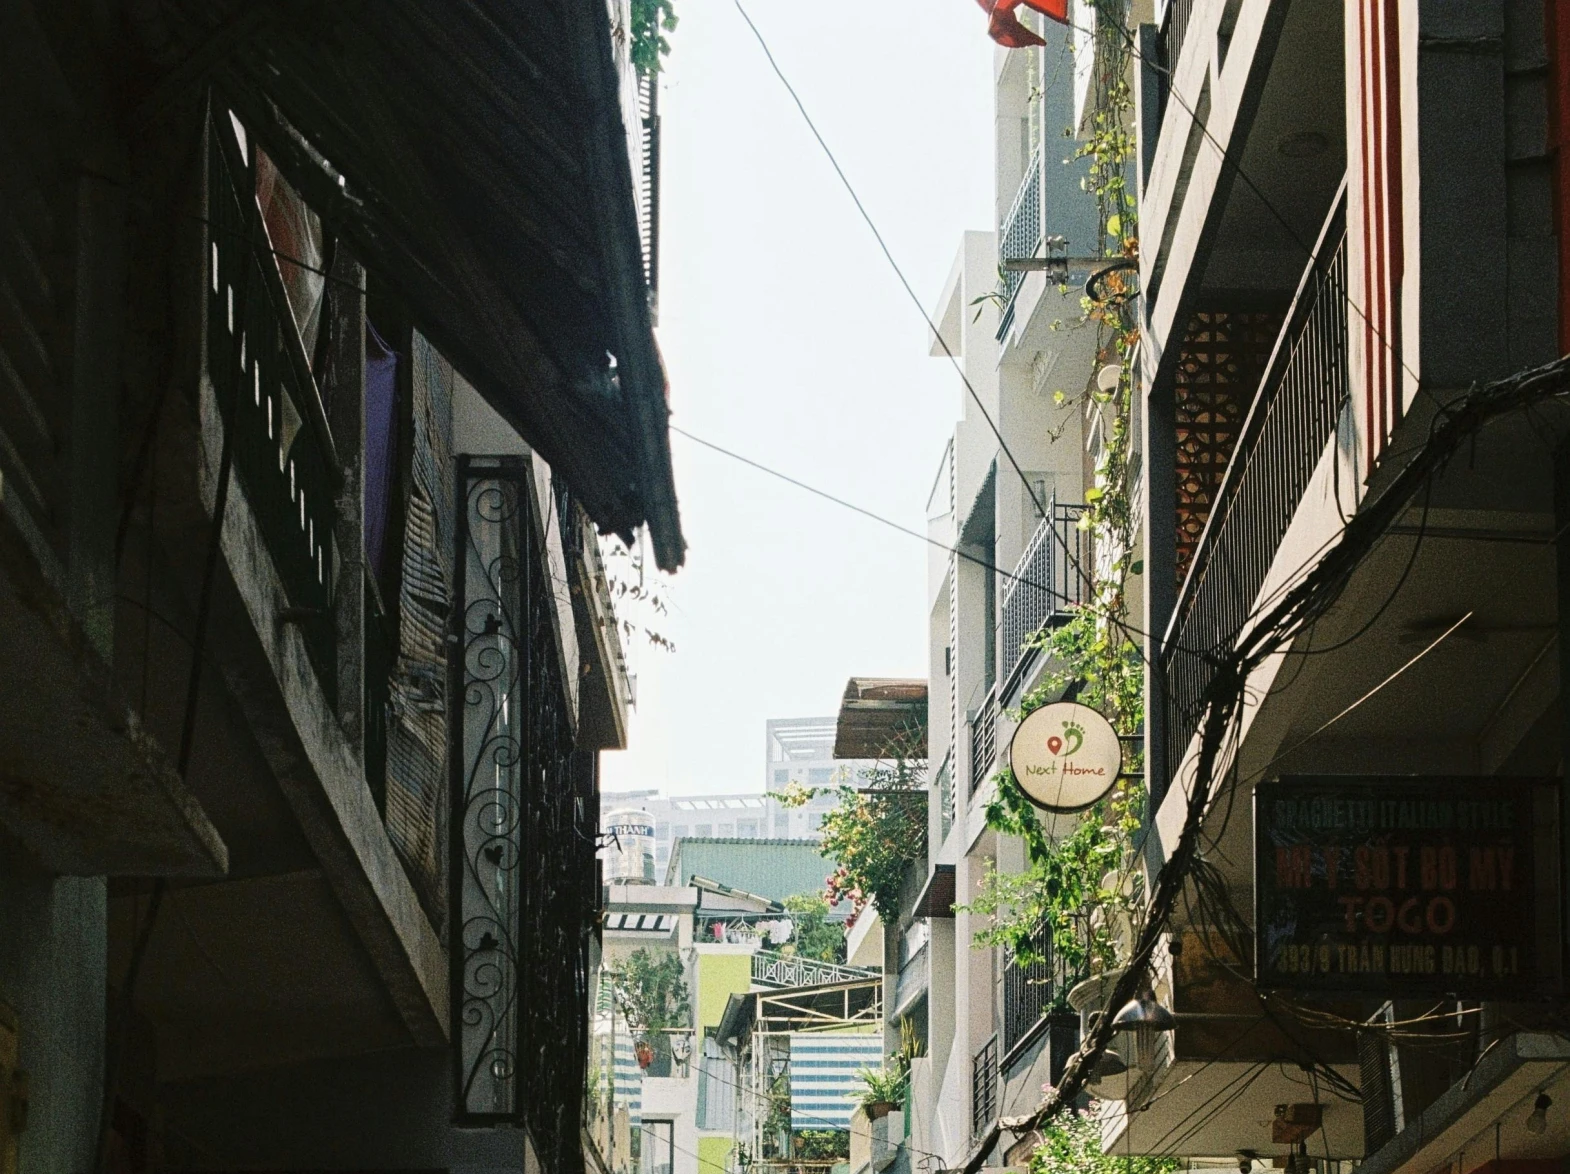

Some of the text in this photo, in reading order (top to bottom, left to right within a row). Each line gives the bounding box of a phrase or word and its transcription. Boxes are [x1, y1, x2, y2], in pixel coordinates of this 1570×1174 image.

[1026, 760, 1105, 776] Next Home
[1380, 799, 1453, 829] ITALIAN
[1458, 800, 1515, 829] STYLE
[1337, 896, 1455, 935] TOGO
[1277, 944, 1331, 975] 393/9
